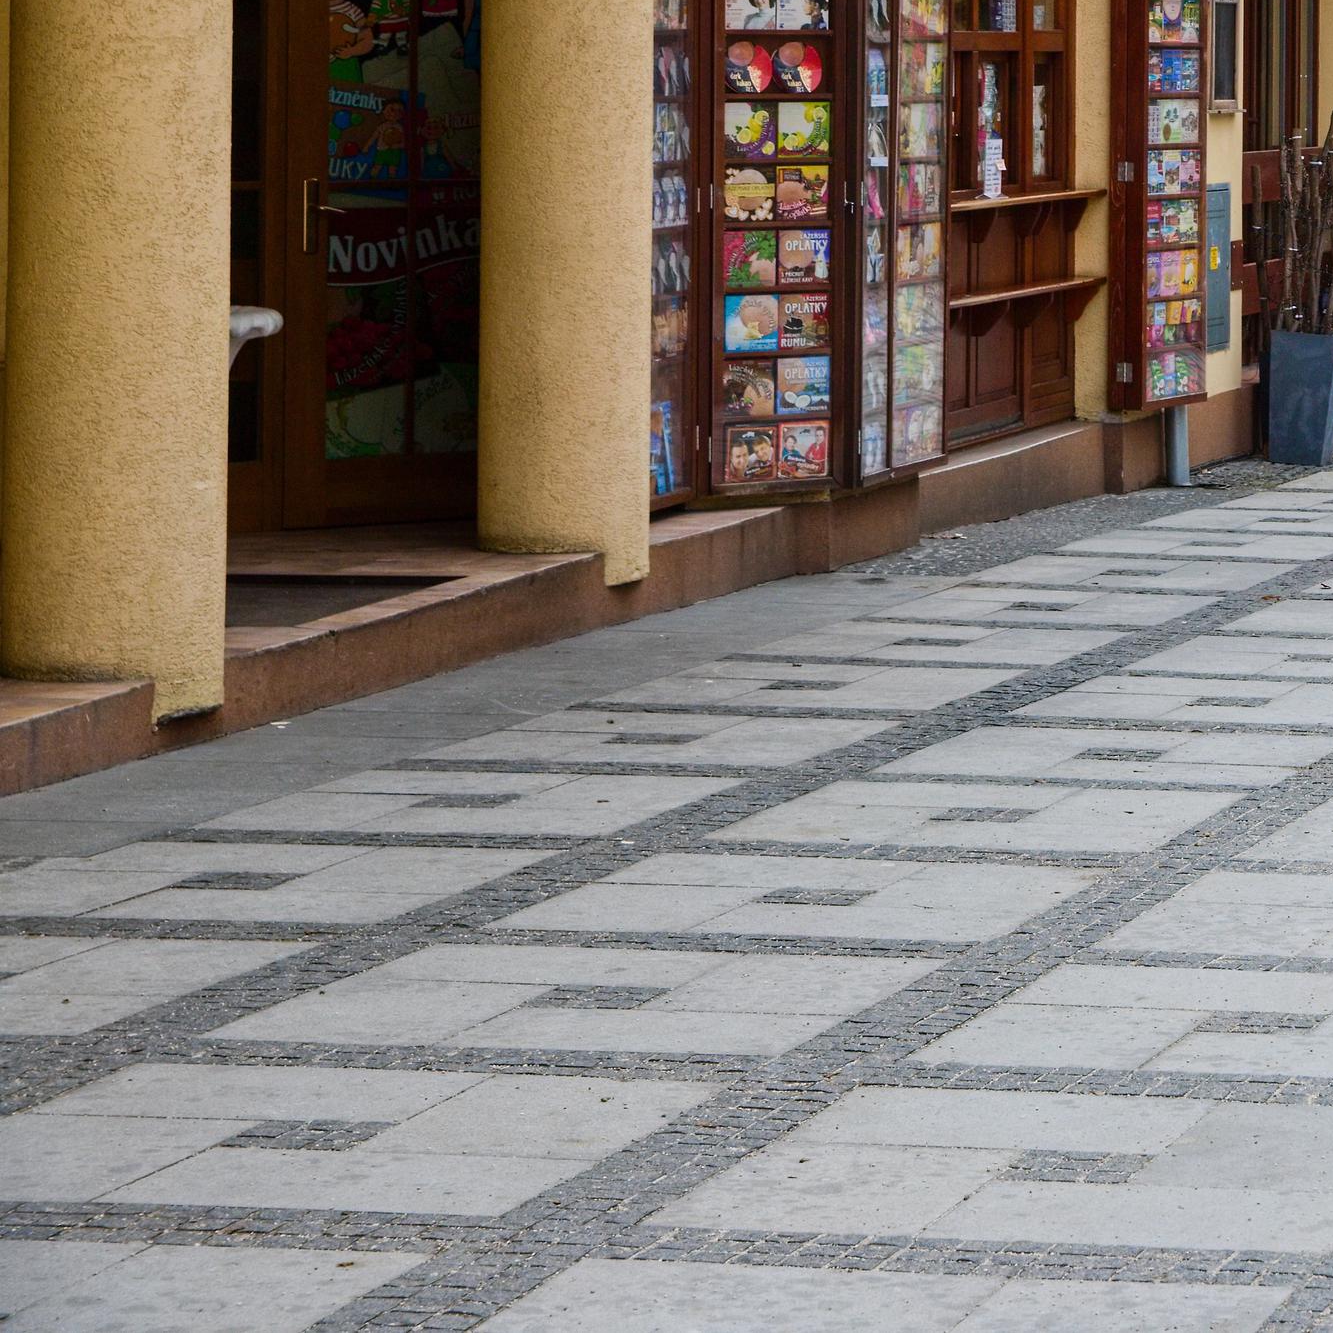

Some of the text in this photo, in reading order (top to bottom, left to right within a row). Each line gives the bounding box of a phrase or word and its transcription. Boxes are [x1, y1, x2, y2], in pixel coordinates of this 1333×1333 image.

[785, 240, 828, 251] OPLATKY
[785, 302, 828, 314] OPLATKY
[781, 338, 806, 347] RUMU
[784, 368, 827, 379] OPLATKY
